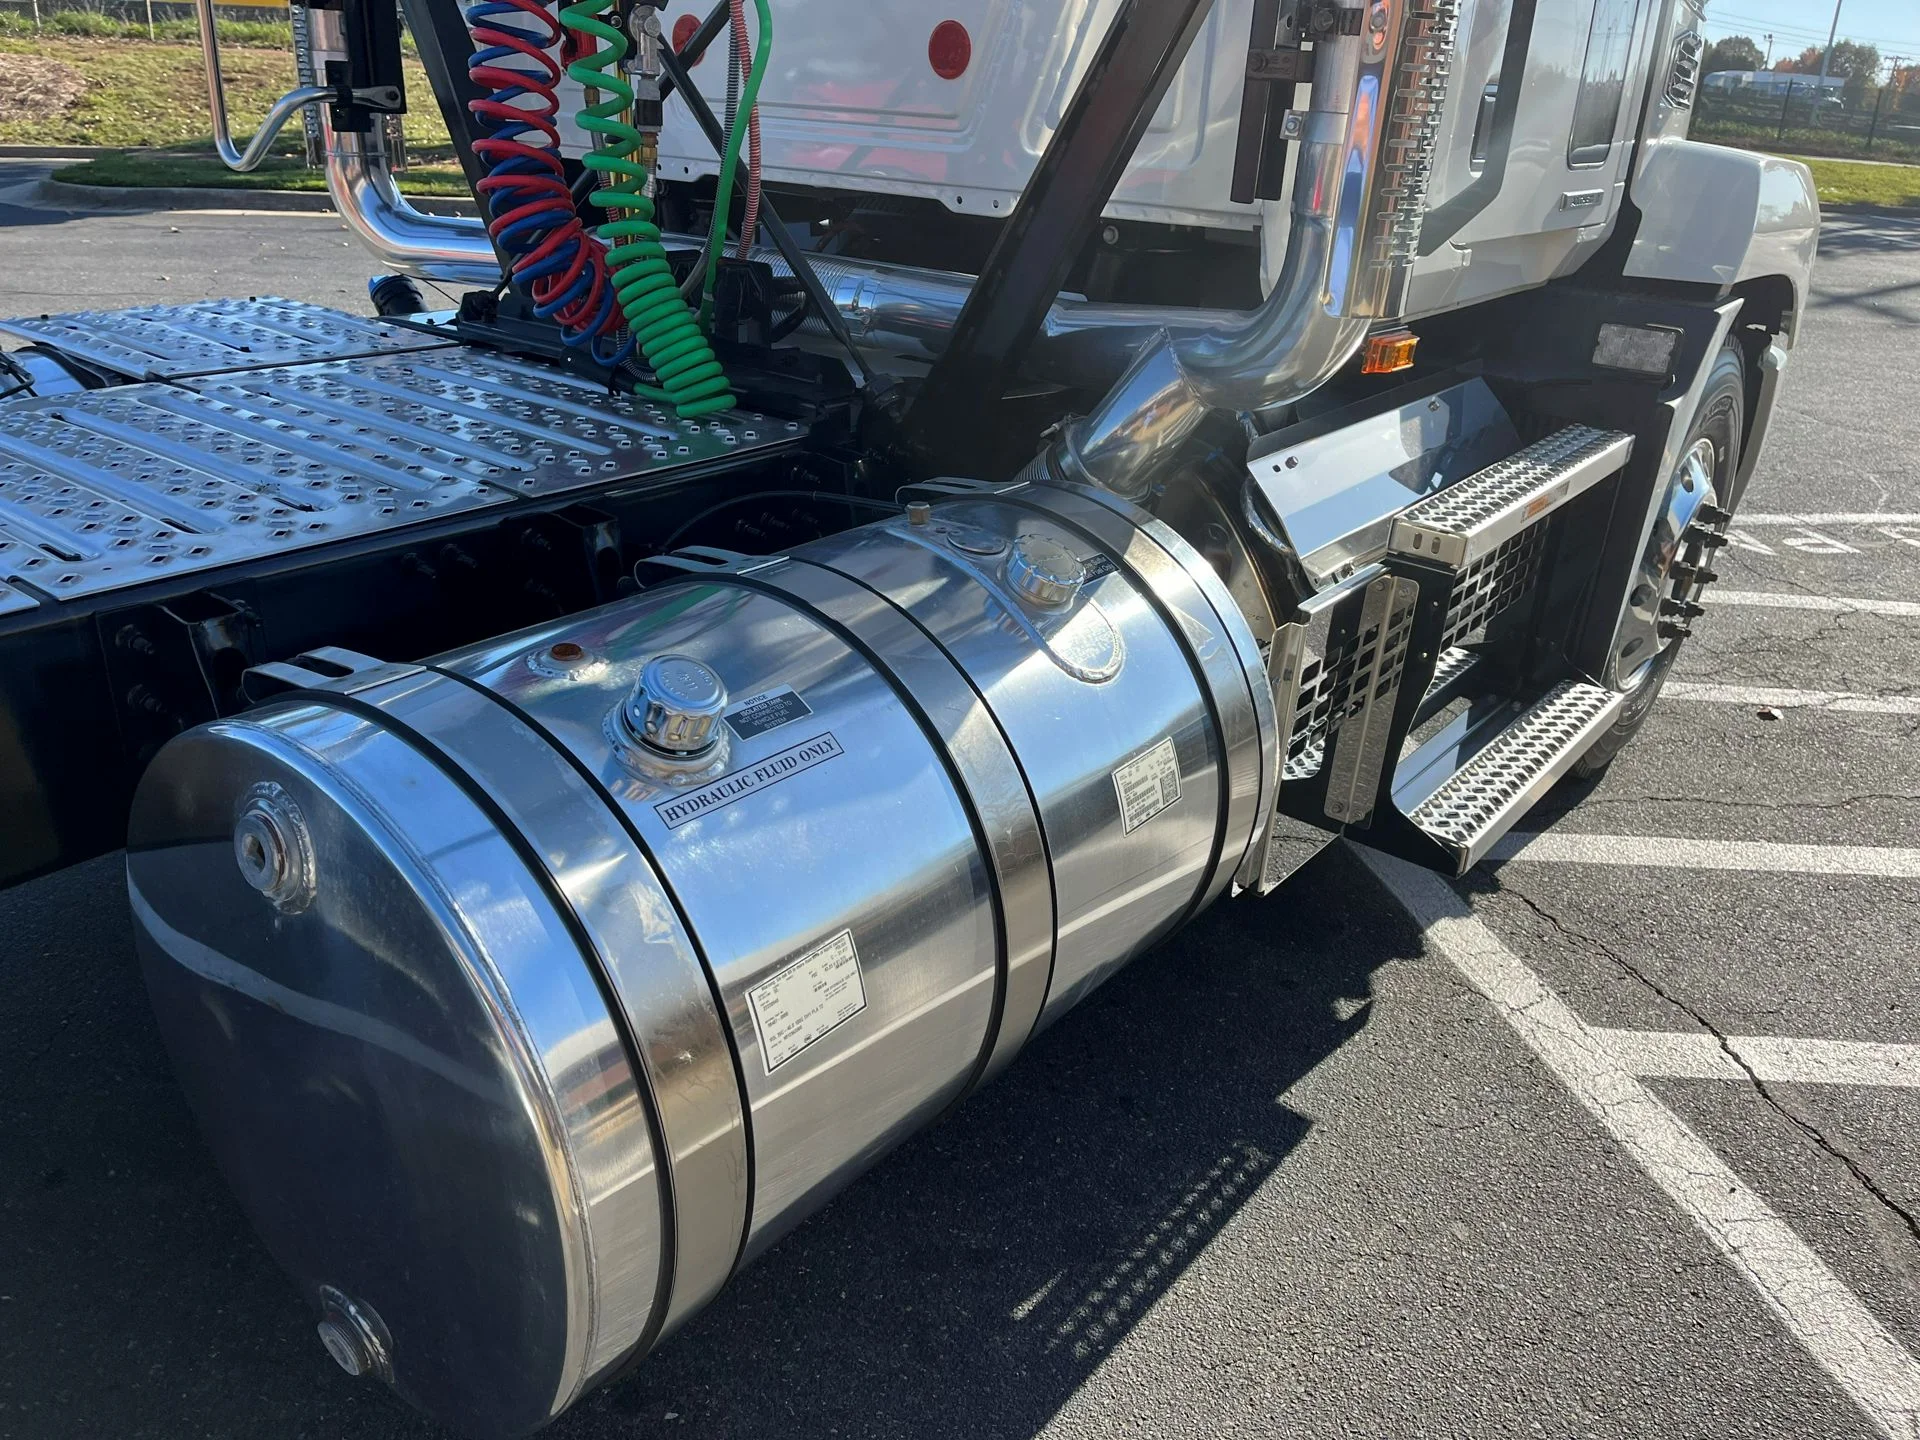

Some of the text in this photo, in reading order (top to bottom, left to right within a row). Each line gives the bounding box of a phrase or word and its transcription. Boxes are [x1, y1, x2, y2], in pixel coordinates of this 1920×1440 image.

[739, 697, 784, 717] ISOLATED TANK
[744, 694, 768, 706] NOTICE
[738, 716, 752, 724] NOT
[751, 704, 784, 720] CONNECTED
[751, 709, 790, 726] VEHICLE FUEL
[764, 717, 787, 729] SYSTEM
[663, 738, 835, 822] HYDRAULIC FLUID ONLY
